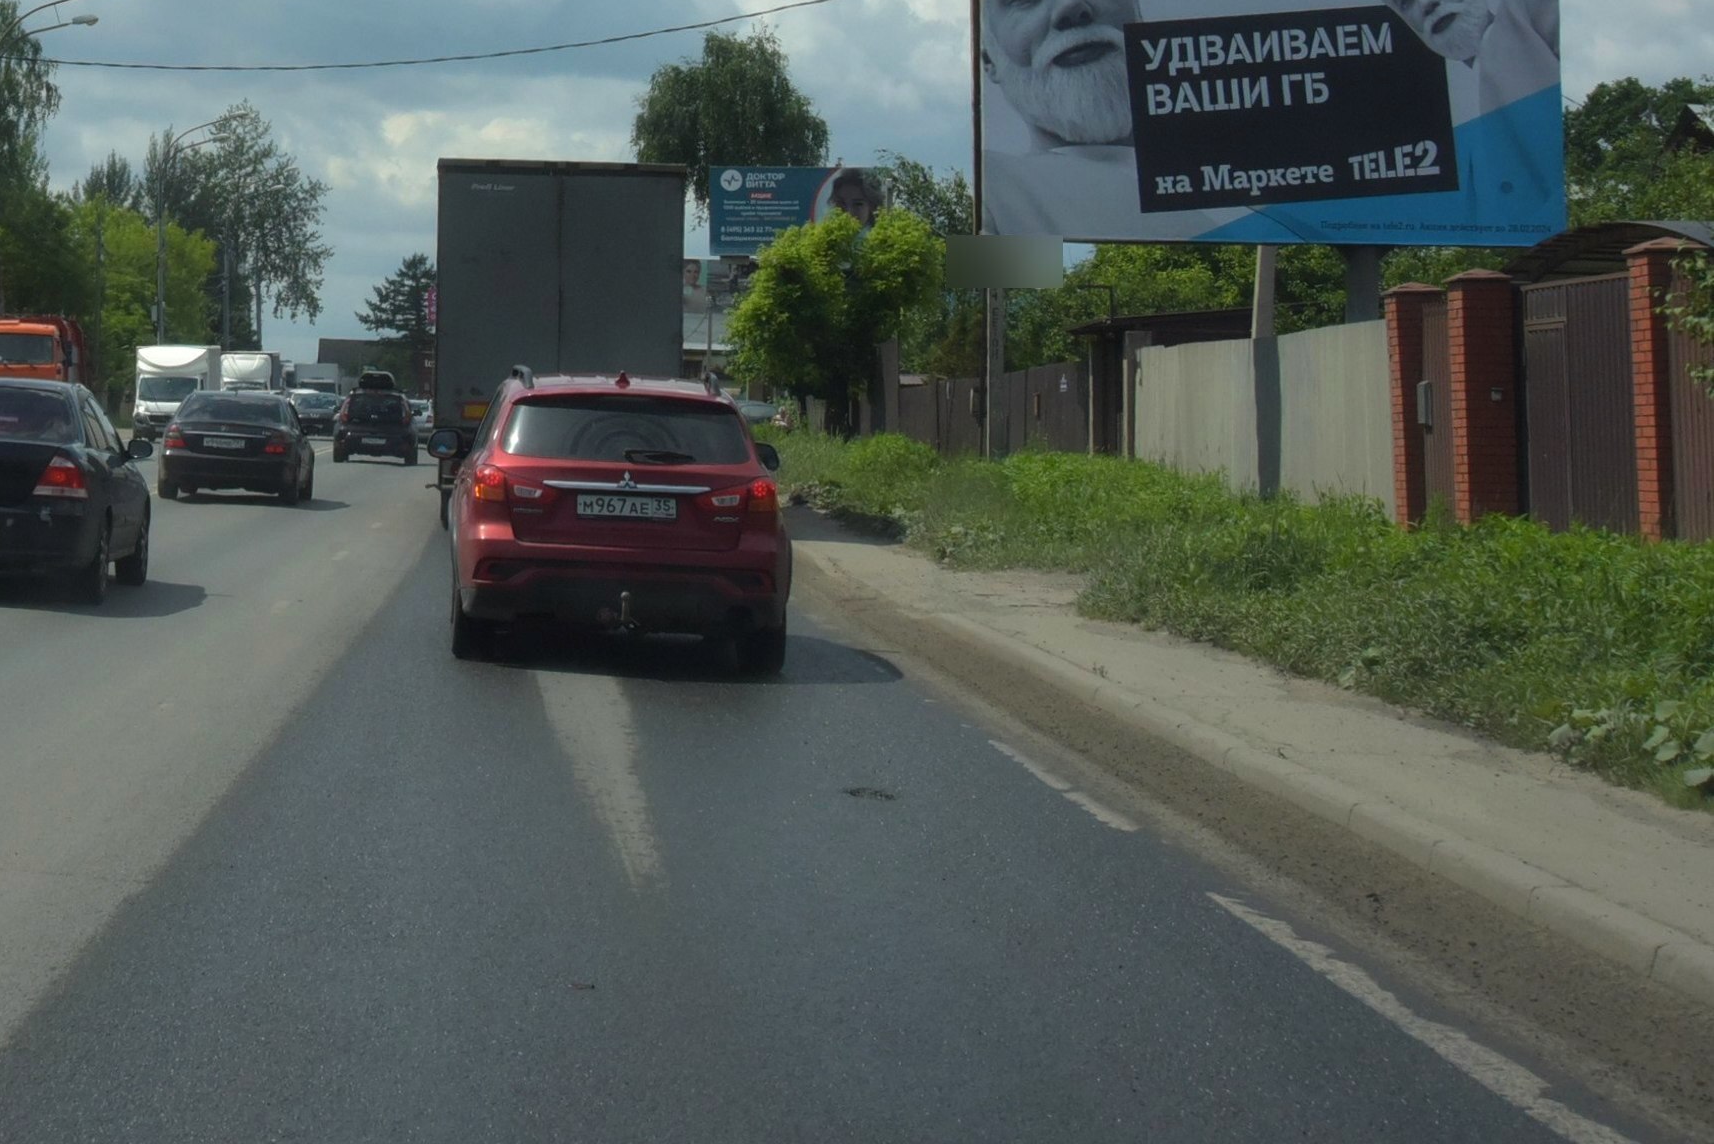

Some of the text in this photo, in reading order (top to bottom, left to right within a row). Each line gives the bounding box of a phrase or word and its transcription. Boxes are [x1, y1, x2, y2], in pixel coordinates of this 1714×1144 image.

[1141, 22, 1393, 77] УДВАИВАЕМ
[1146, 72, 1330, 116] ВАШИ ГБ
[1155, 140, 1440, 196] на Маркете TELE2
